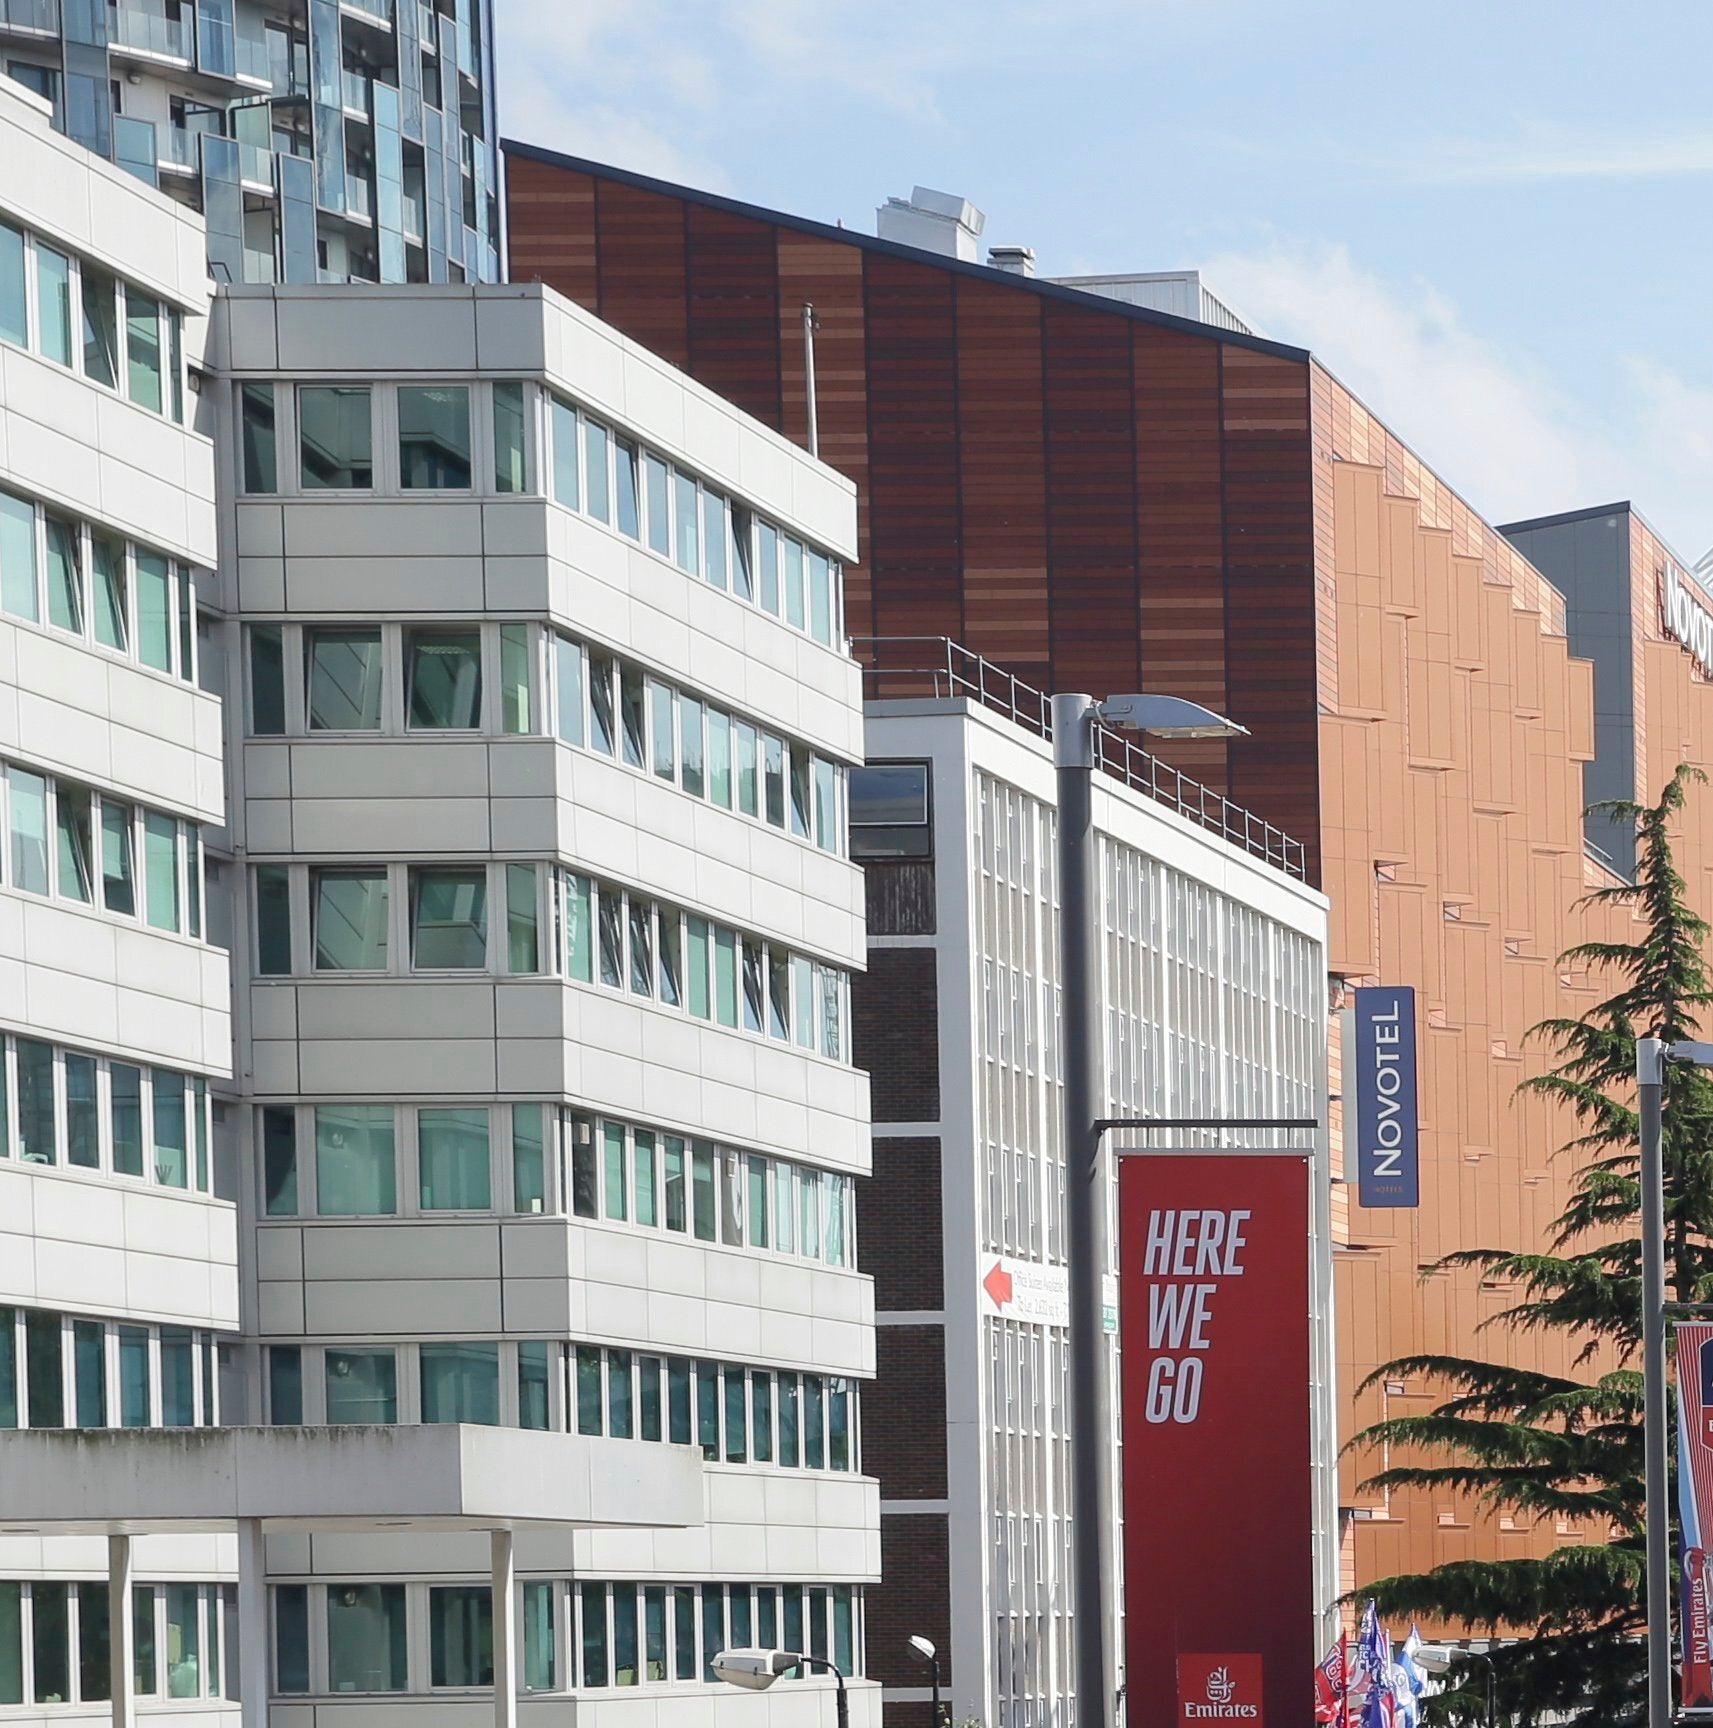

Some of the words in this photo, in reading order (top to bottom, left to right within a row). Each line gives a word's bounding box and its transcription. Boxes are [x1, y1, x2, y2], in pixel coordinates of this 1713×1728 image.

[1372, 1000, 1402, 1177] NOVOTEL
[1143, 1209, 1251, 1275] HERE
[1149, 1283, 1217, 1349] WE
[1144, 1356, 1203, 1422] GO
[1692, 1576, 1709, 1641] Emirates
[1693, 1641, 1708, 1664] Fly
[1184, 1702, 1257, 1718] Emirates
